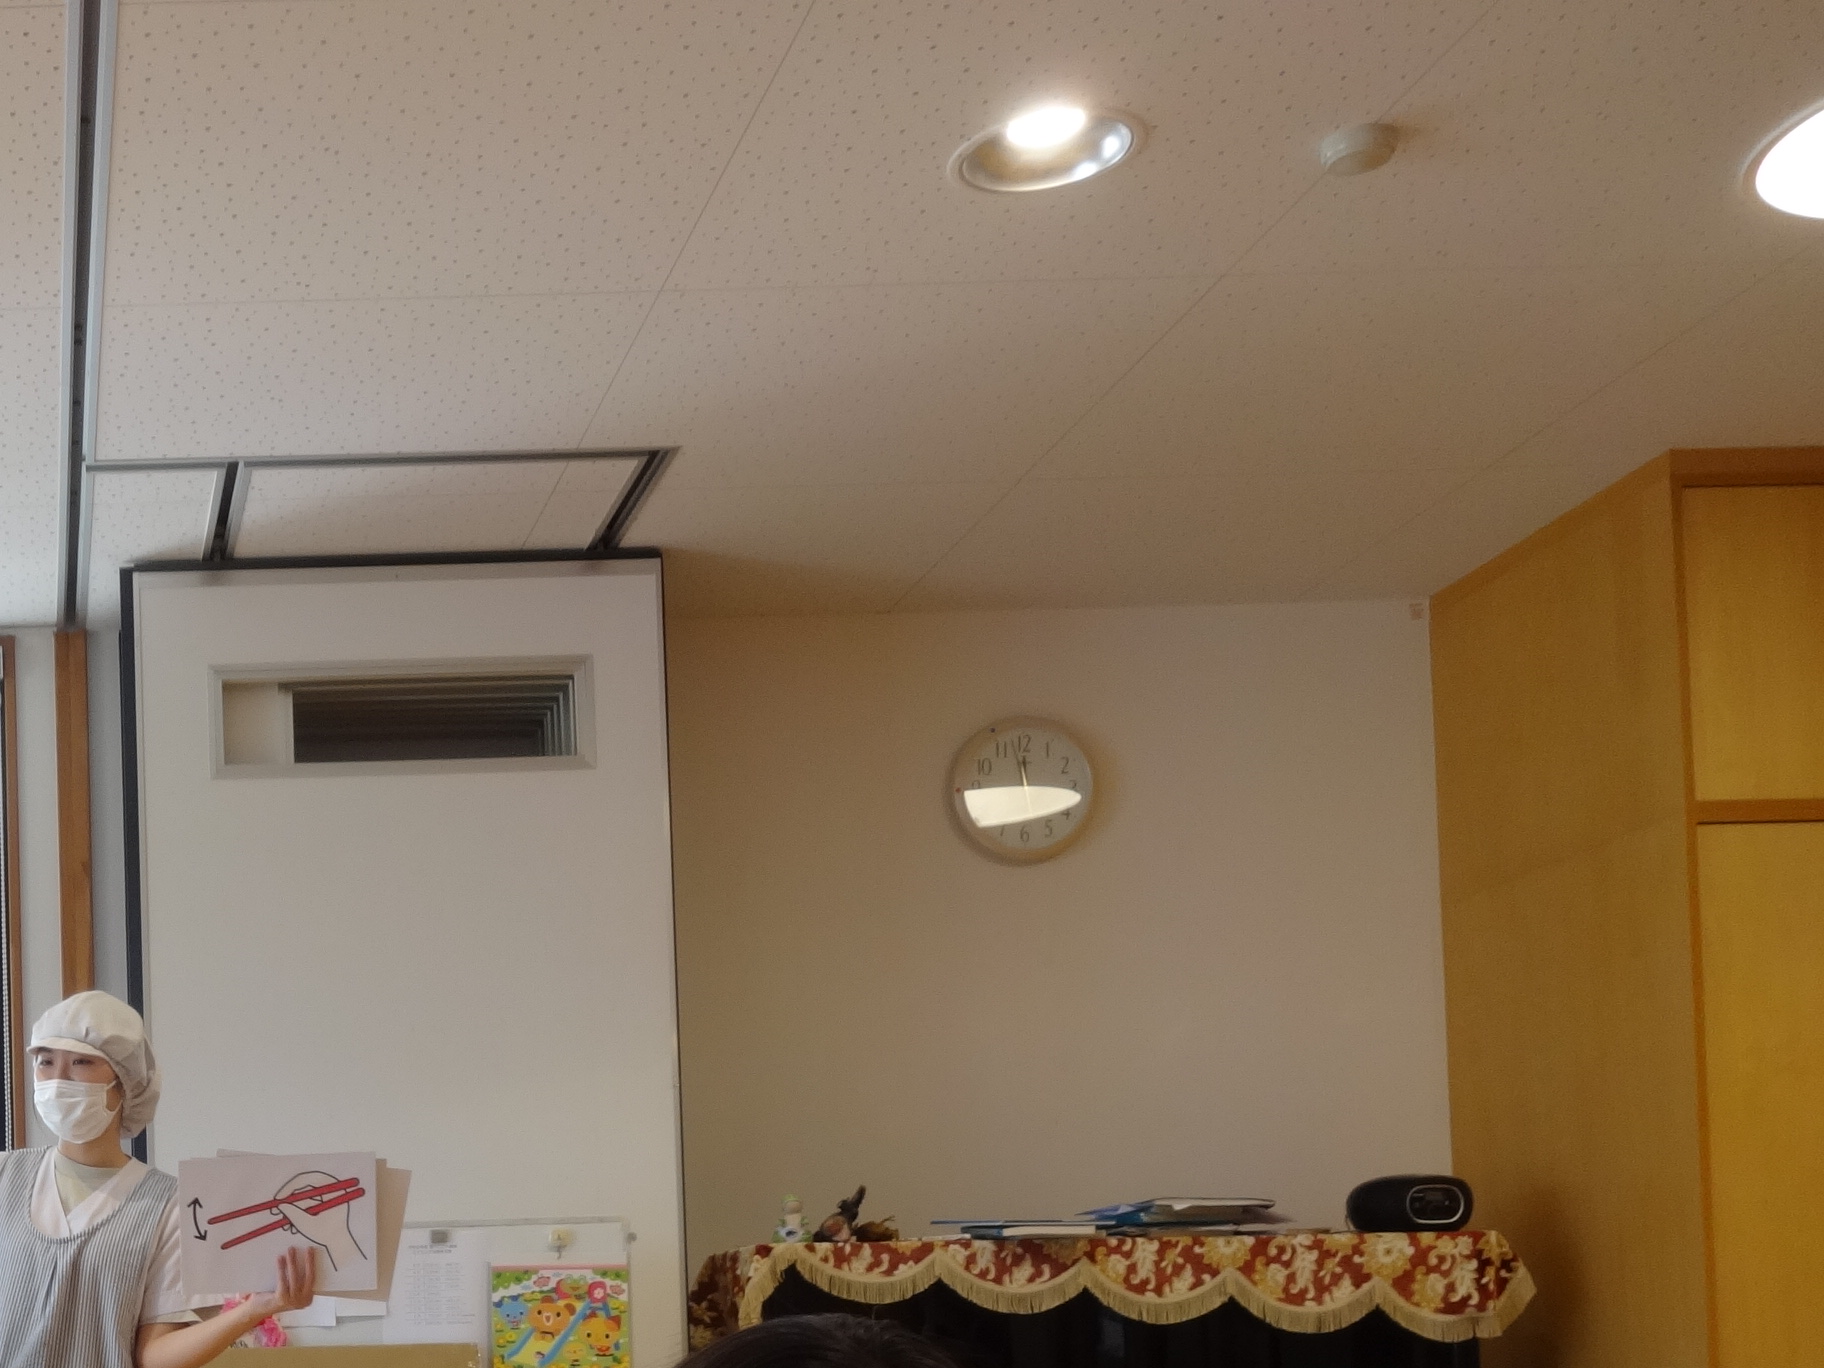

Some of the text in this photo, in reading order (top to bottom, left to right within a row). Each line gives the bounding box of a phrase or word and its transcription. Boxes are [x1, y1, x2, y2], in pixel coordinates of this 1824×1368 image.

[995, 741, 1007, 758] 11
[1017, 734, 1032, 753] 12
[977, 758, 992, 775] 10
[1061, 756, 1070, 775] 2
[1019, 826, 1030, 842] 6
[1044, 819, 1053, 838] 5
